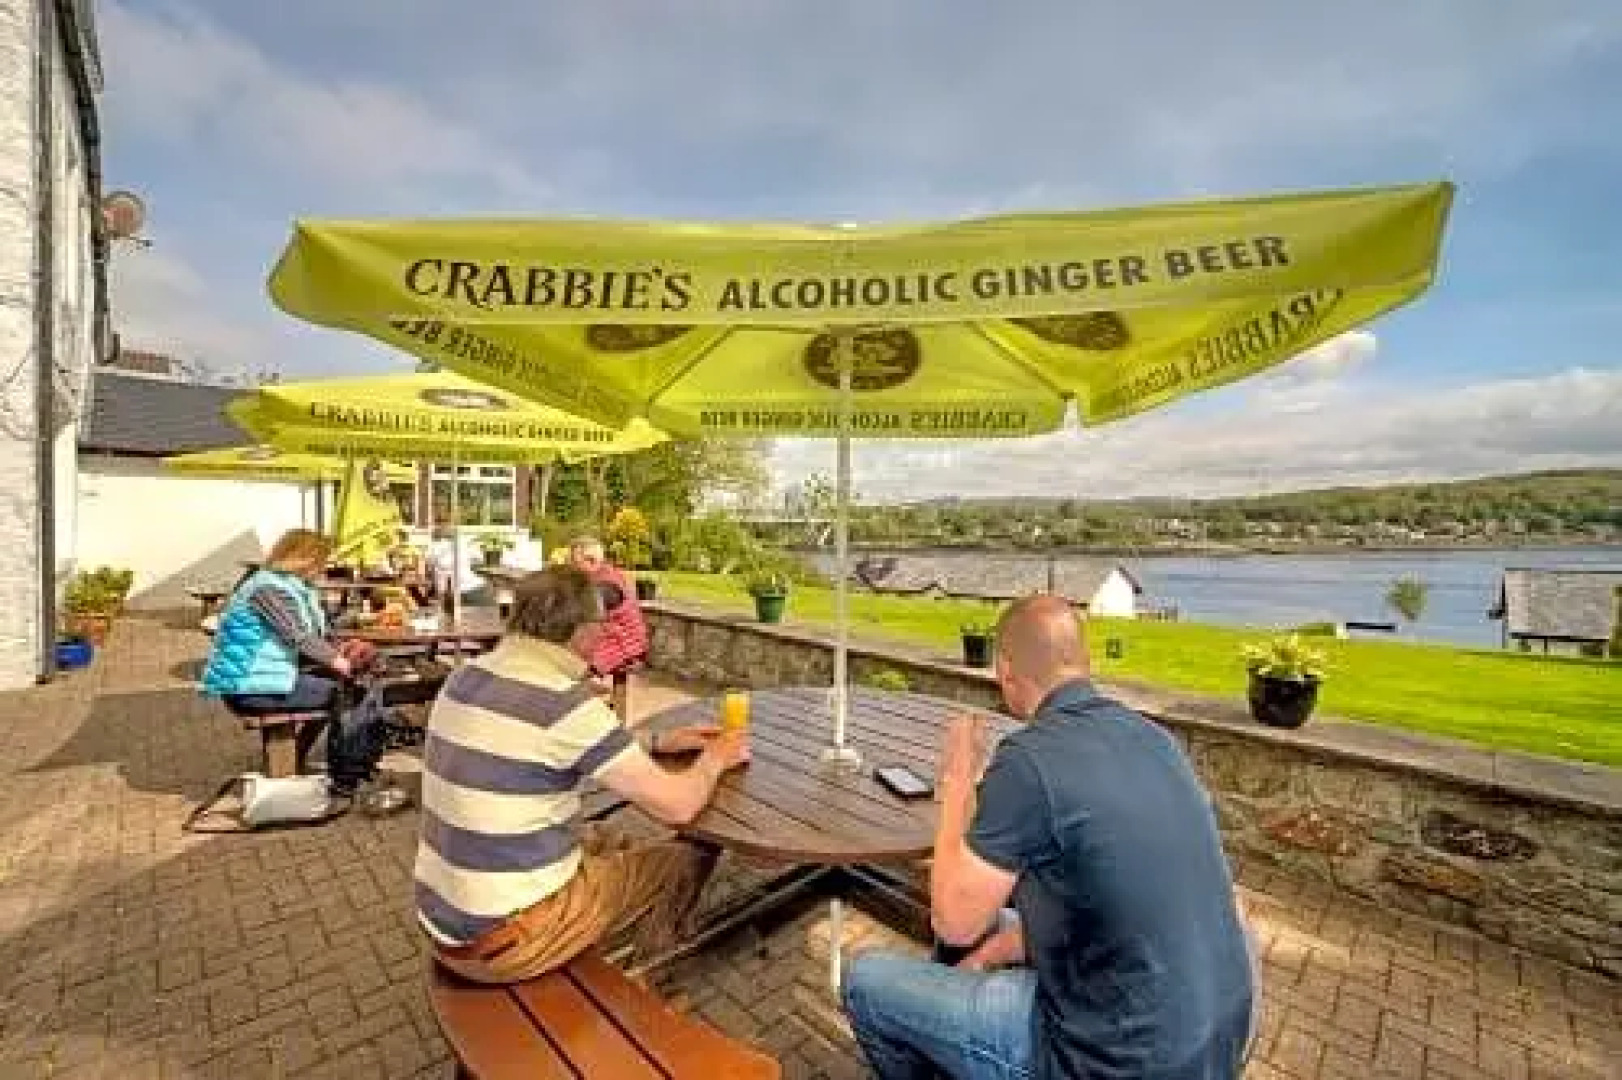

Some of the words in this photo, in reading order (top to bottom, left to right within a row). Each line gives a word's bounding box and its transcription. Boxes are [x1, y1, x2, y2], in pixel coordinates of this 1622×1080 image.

[405, 258, 692, 311] CRABBIE'S
[717, 271, 958, 310] ALCOHOLIC
[972, 258, 1149, 300] GINGER
[1166, 235, 1290, 277] BEER
